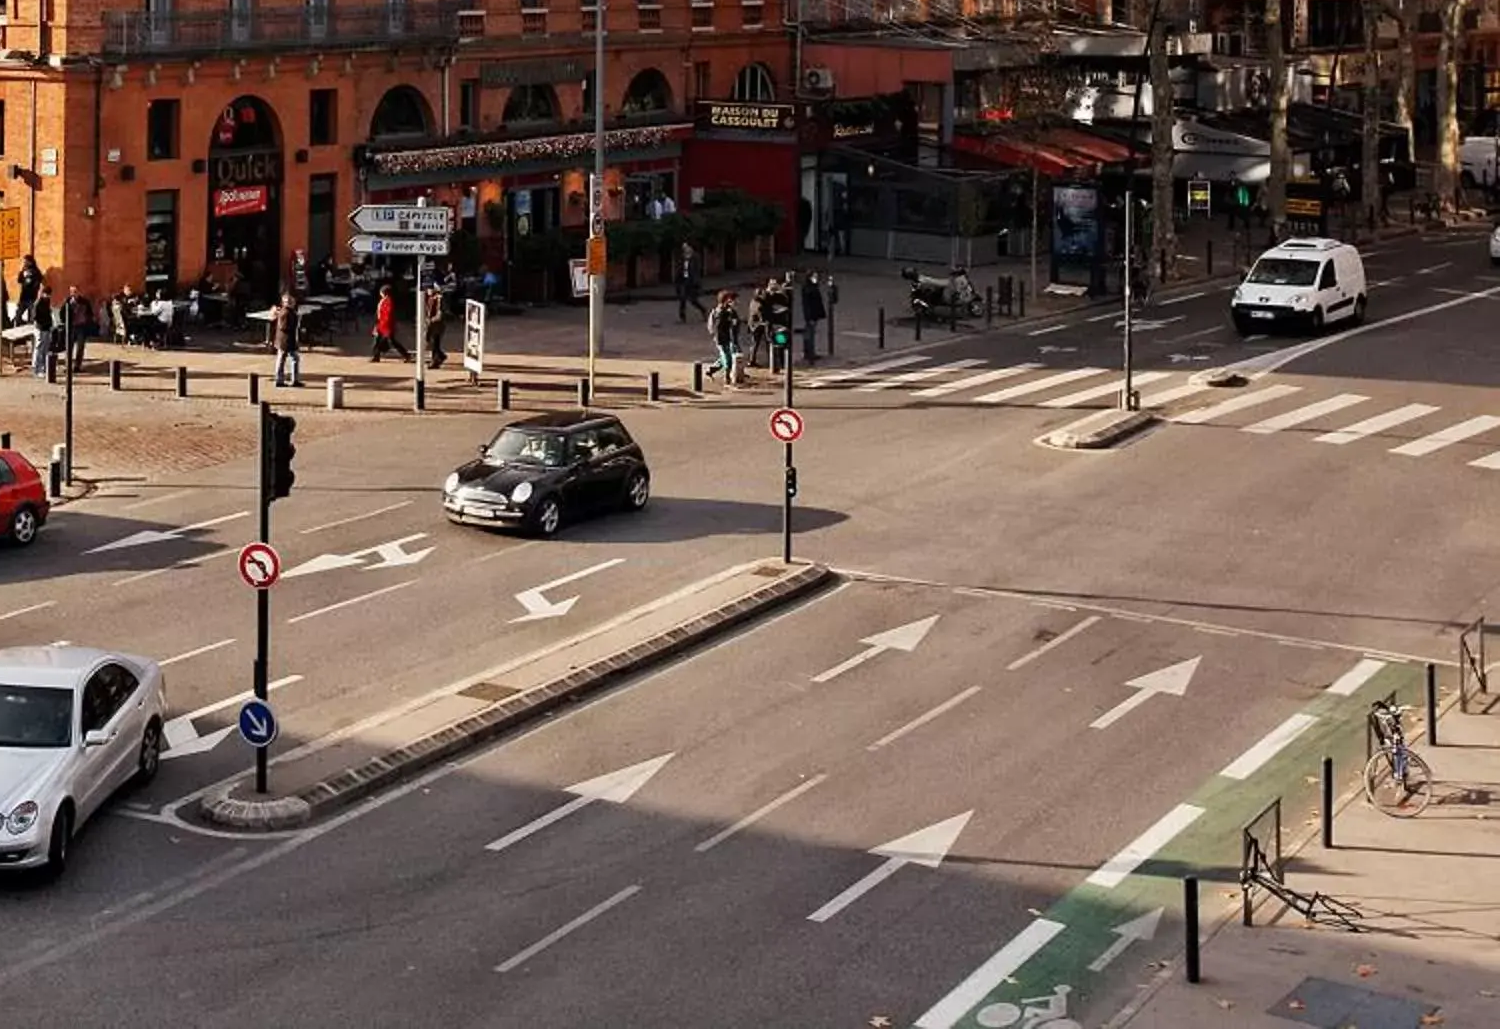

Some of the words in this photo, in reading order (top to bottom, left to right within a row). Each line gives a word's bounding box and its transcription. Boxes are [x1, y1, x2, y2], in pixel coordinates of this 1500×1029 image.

[712, 107, 759, 118] MAISON
[762, 109, 778, 118] DU
[711, 117, 778, 128] CASSOULET
[217, 155, 277, 187] Quick
